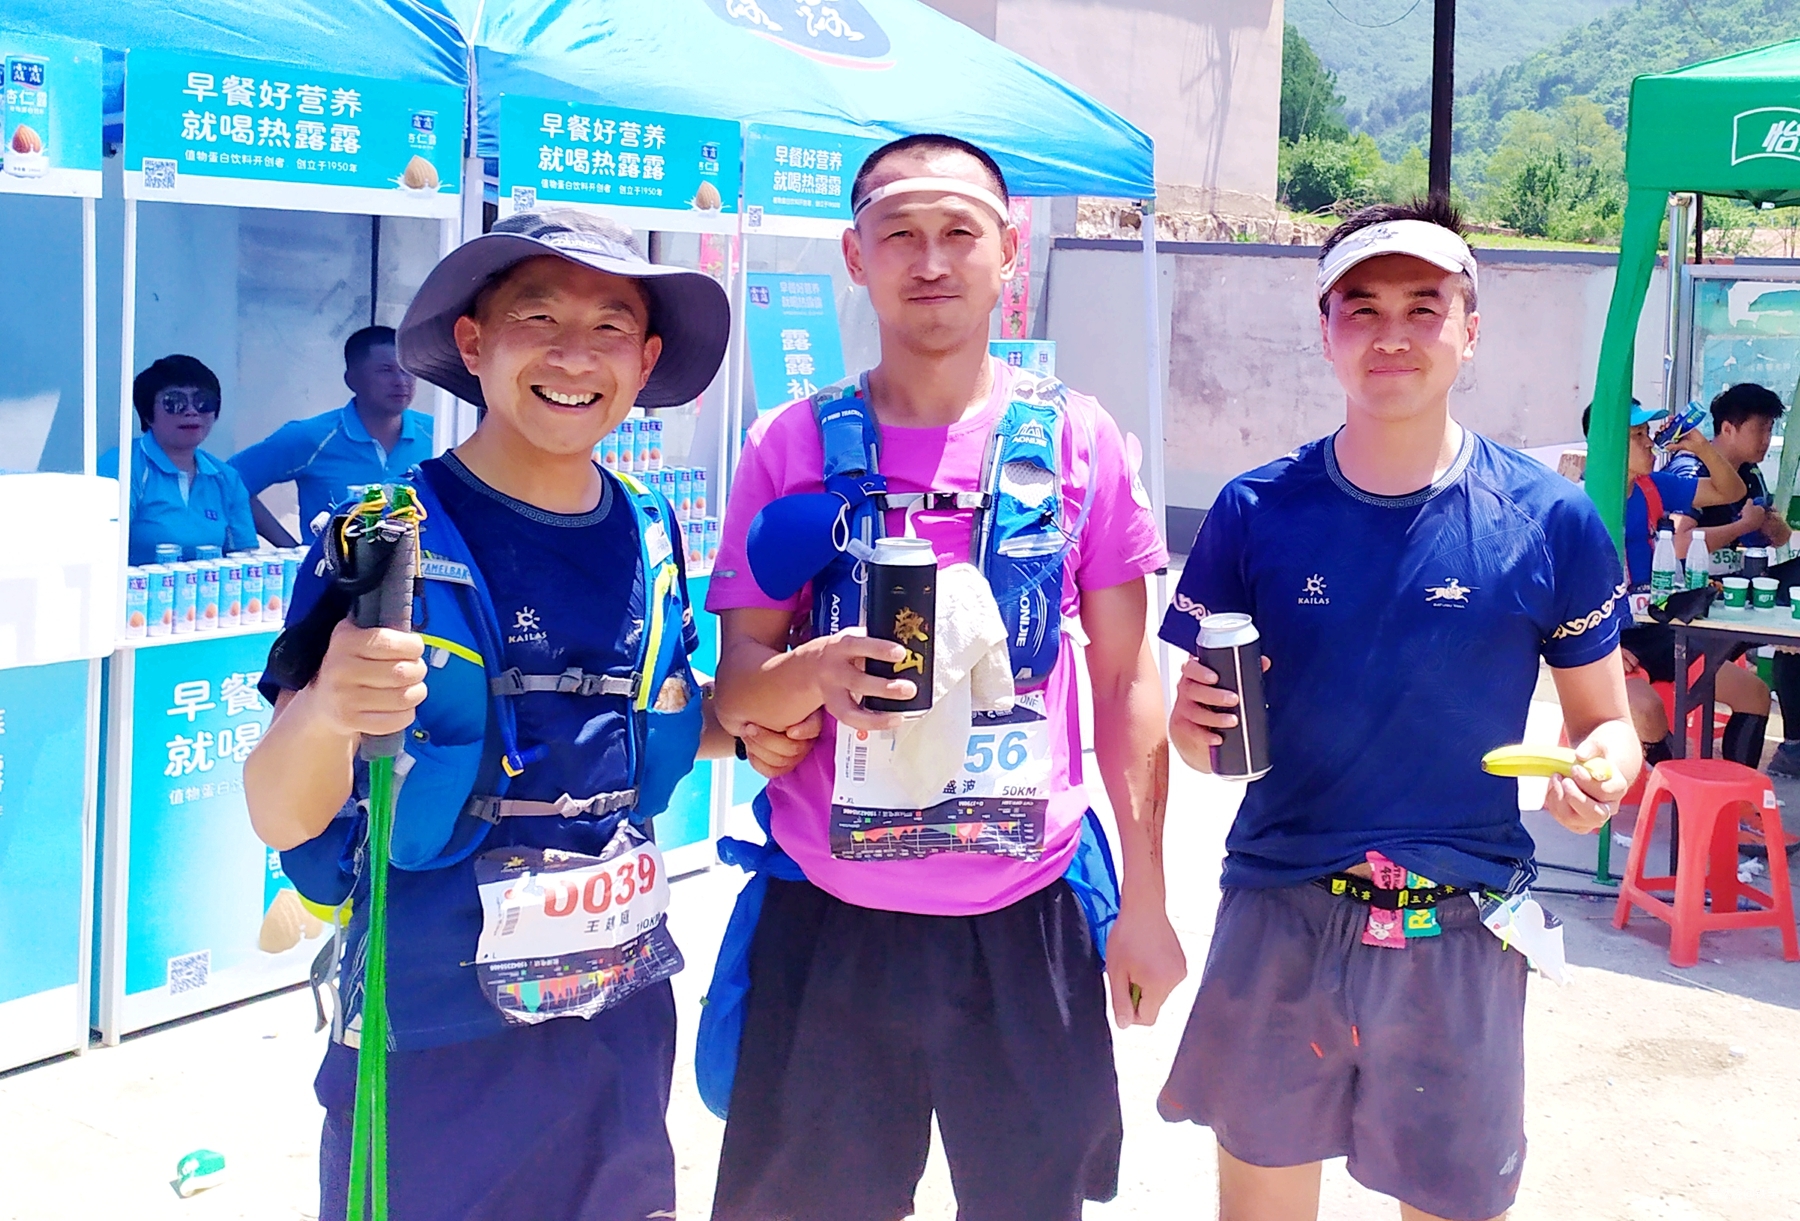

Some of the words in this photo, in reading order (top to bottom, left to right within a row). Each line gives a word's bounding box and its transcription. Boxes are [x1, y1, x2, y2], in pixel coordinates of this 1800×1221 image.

[182, 72, 362, 118] 早餐好营养
[181, 110, 361, 154] 就喝热露露
[539, 113, 666, 149] 早餐好营养
[296, 158, 357, 173] 创立于1950年
[538, 145, 665, 181] 就喝热露露
[774, 145, 842, 171] 早餐好营养
[773, 170, 841, 196] 就喝热露露
[830, 594, 841, 636] AONI
[1016, 586, 1030, 647] AONIJIE
[508, 631, 547, 643] KAILAS
[164, 721, 261, 777] 就喝
[1002, 786, 1037, 796] 50KM
[544, 854, 656, 917] 0039
